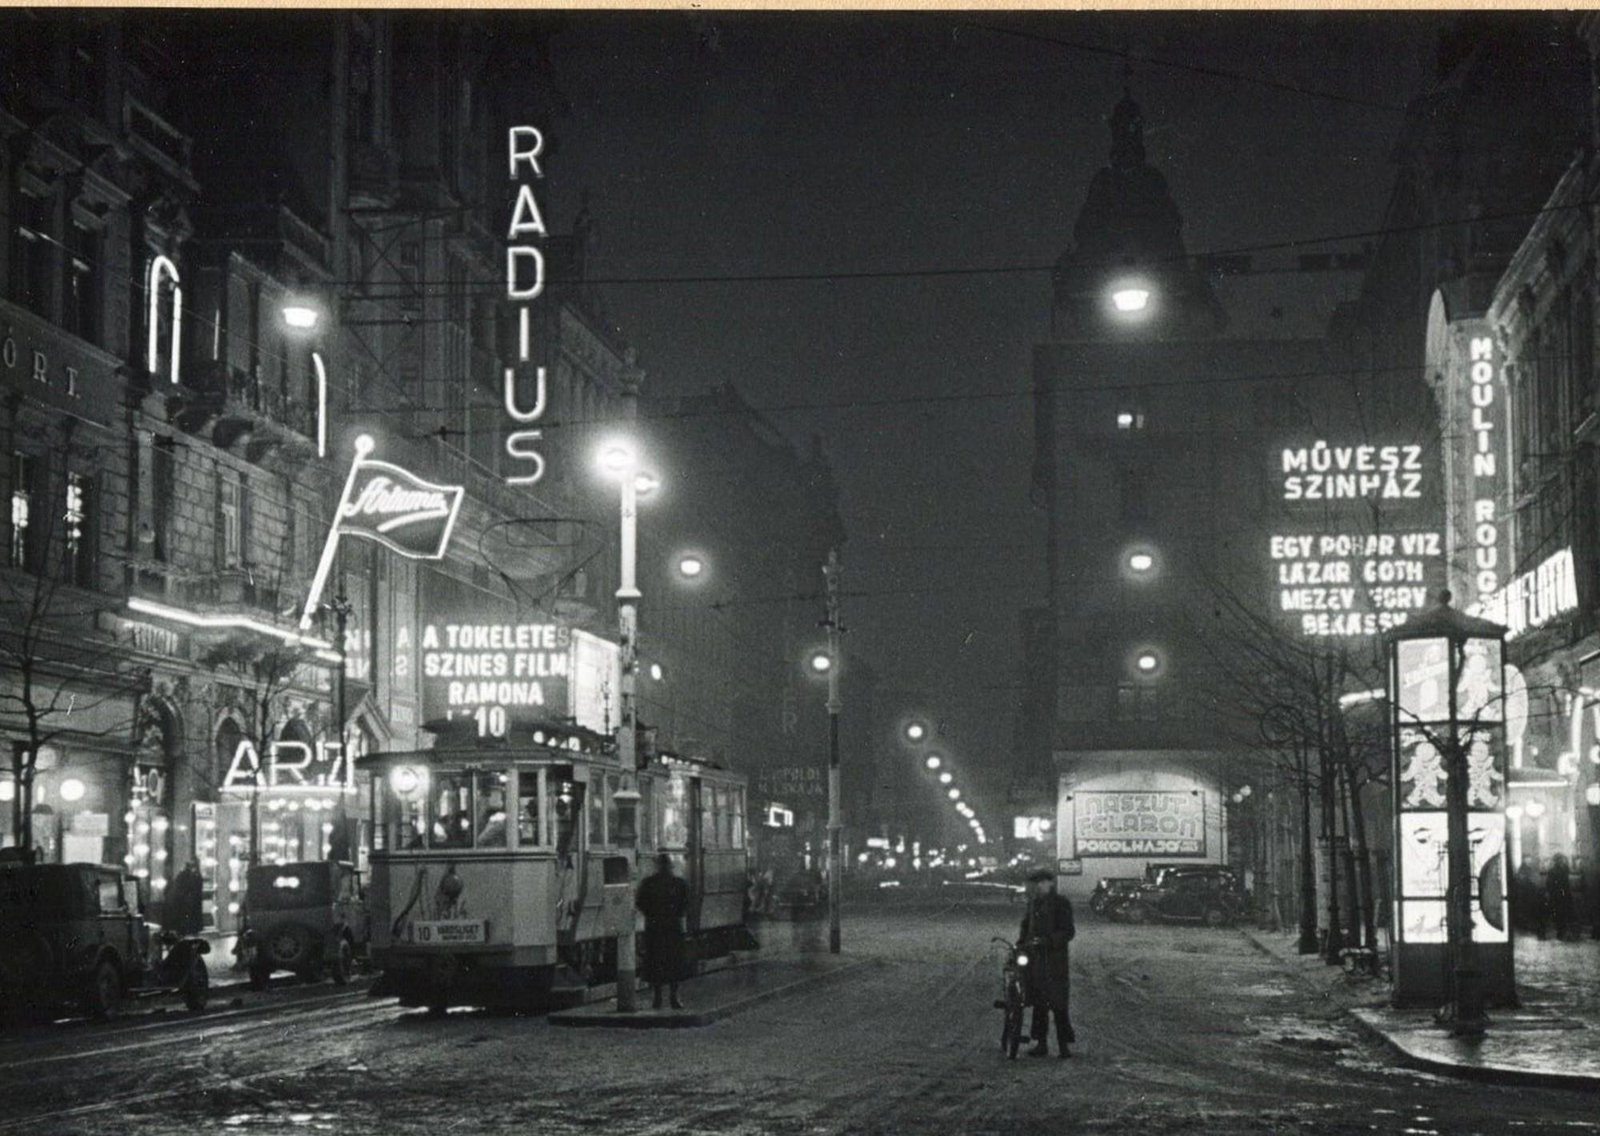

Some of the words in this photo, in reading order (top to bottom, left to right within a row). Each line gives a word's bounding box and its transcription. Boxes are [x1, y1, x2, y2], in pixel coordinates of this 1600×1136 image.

[504, 126, 547, 484] RADIUS
[1470, 337, 1496, 477] MOULIN
[1270, 536, 1313, 558] EGY
[1401, 533, 1441, 555] VIZ
[423, 625, 440, 648] A
[424, 653, 508, 677] SZINES
[514, 653, 567, 676] FILM
[448, 681, 545, 705] RAMONA
[474, 706, 506, 737] 10
[418, 926, 431, 940] 10
